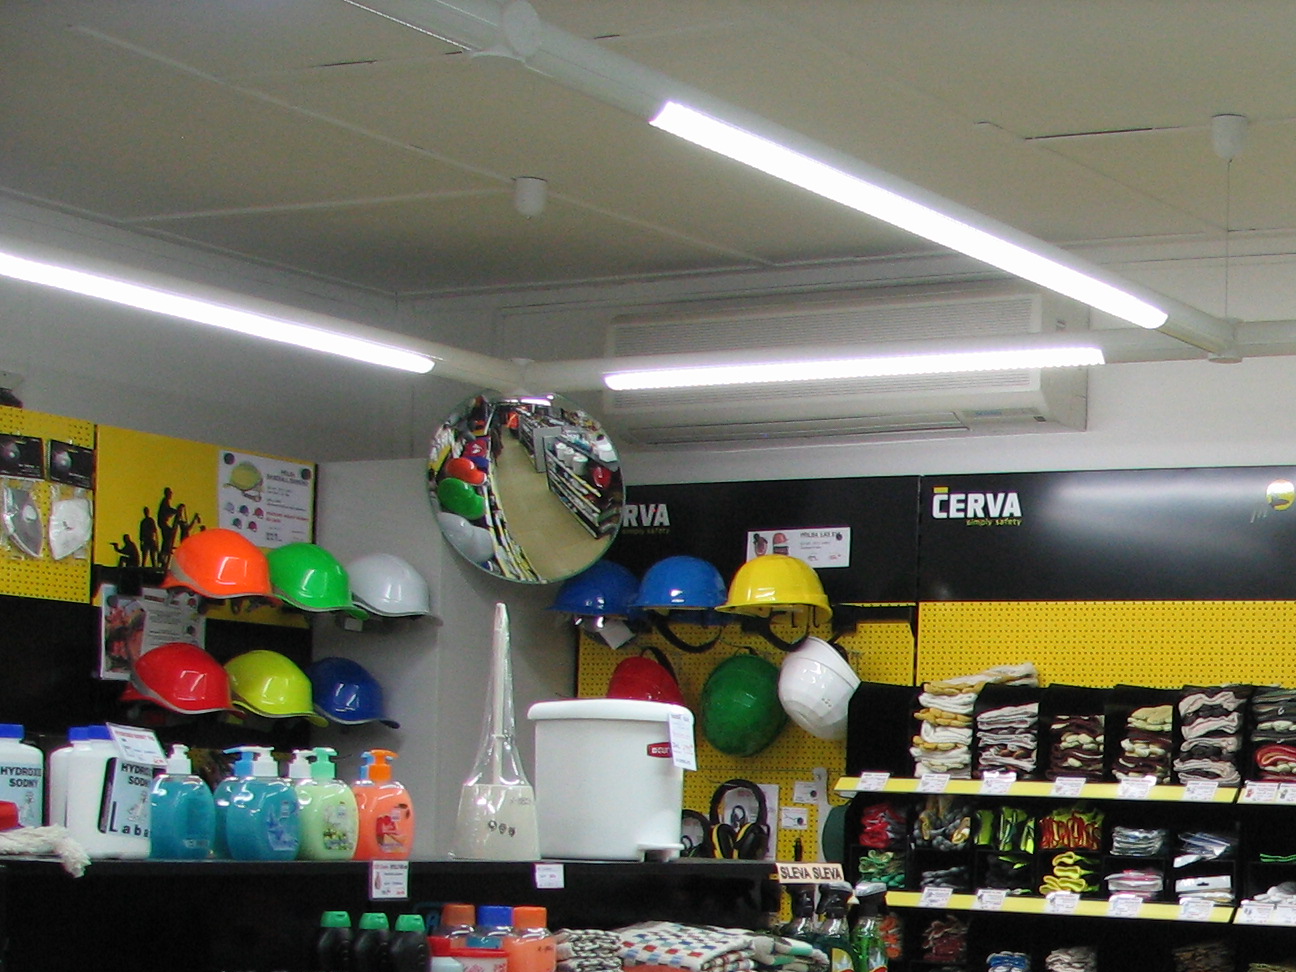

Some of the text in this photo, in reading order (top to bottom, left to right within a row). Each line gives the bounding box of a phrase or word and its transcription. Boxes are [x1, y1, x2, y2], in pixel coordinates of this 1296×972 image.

[622, 503, 670, 527] RVA
[780, 866, 842, 881] SLEVA SLEVA
